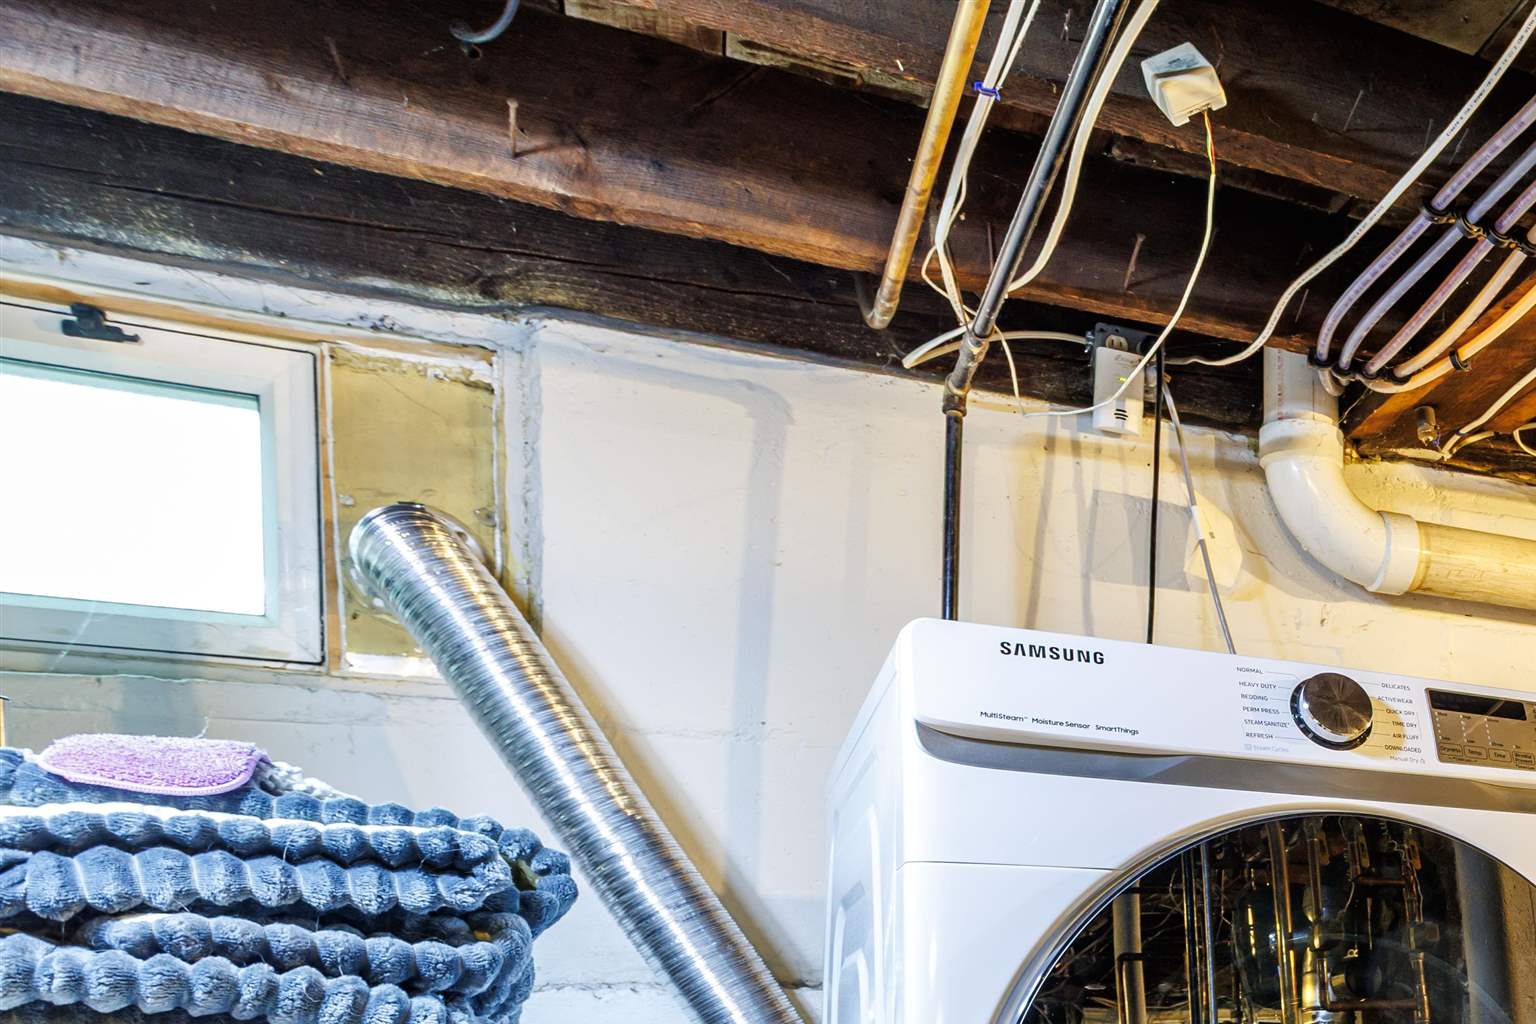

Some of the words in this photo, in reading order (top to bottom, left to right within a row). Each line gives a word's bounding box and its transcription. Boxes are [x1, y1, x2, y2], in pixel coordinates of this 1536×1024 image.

[999, 641, 1105, 665] SAMSUNG
[1236, 667, 1264, 675] NORMAL
[1381, 682, 1411, 691] DELICATES
[1240, 693, 1269, 701] BEDDING
[1377, 695, 1413, 704] ACTIVEWEAR
[1260, 707, 1280, 715] PRESS
[1031, 717, 1064, 727] Moisture
[1065, 720, 1091, 729] Sensor
[1095, 724, 1140, 736] SmartThings
[1392, 720, 1405, 728] TIME
[1245, 731, 1274, 739] REFRESH
[1384, 744, 1422, 754] DOWNLOADED
